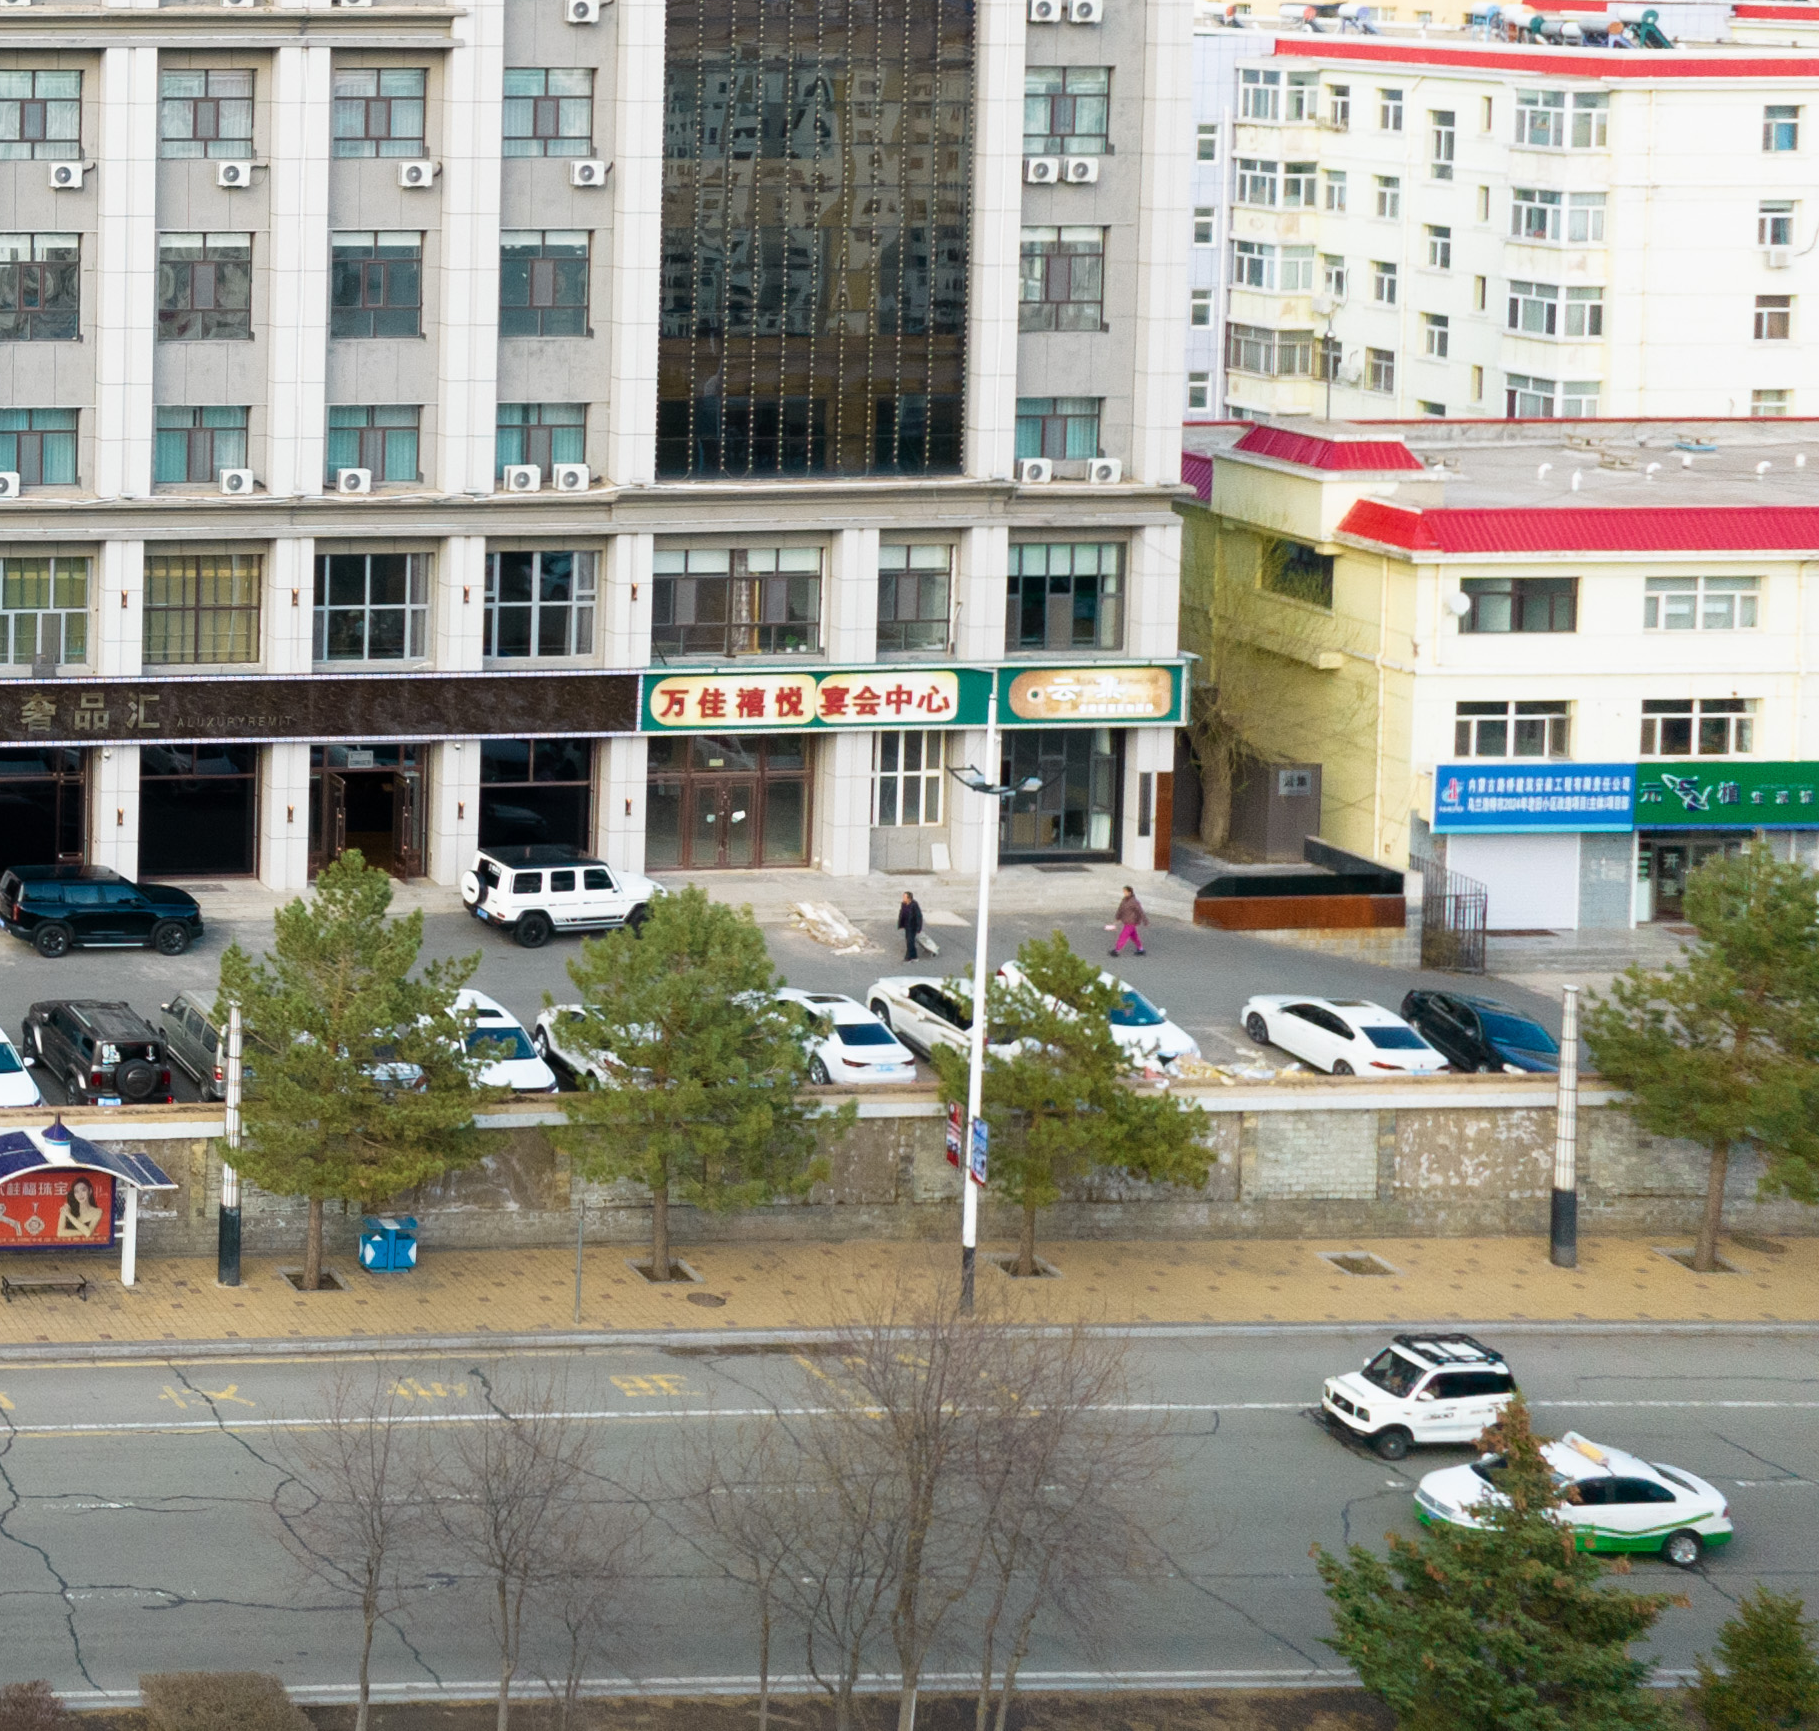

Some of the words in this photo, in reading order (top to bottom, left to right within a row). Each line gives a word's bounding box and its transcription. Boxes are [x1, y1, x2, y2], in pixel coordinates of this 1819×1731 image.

[19, 692, 161, 733] 奢品汇
[819, 683, 952, 717] 宴会中心
